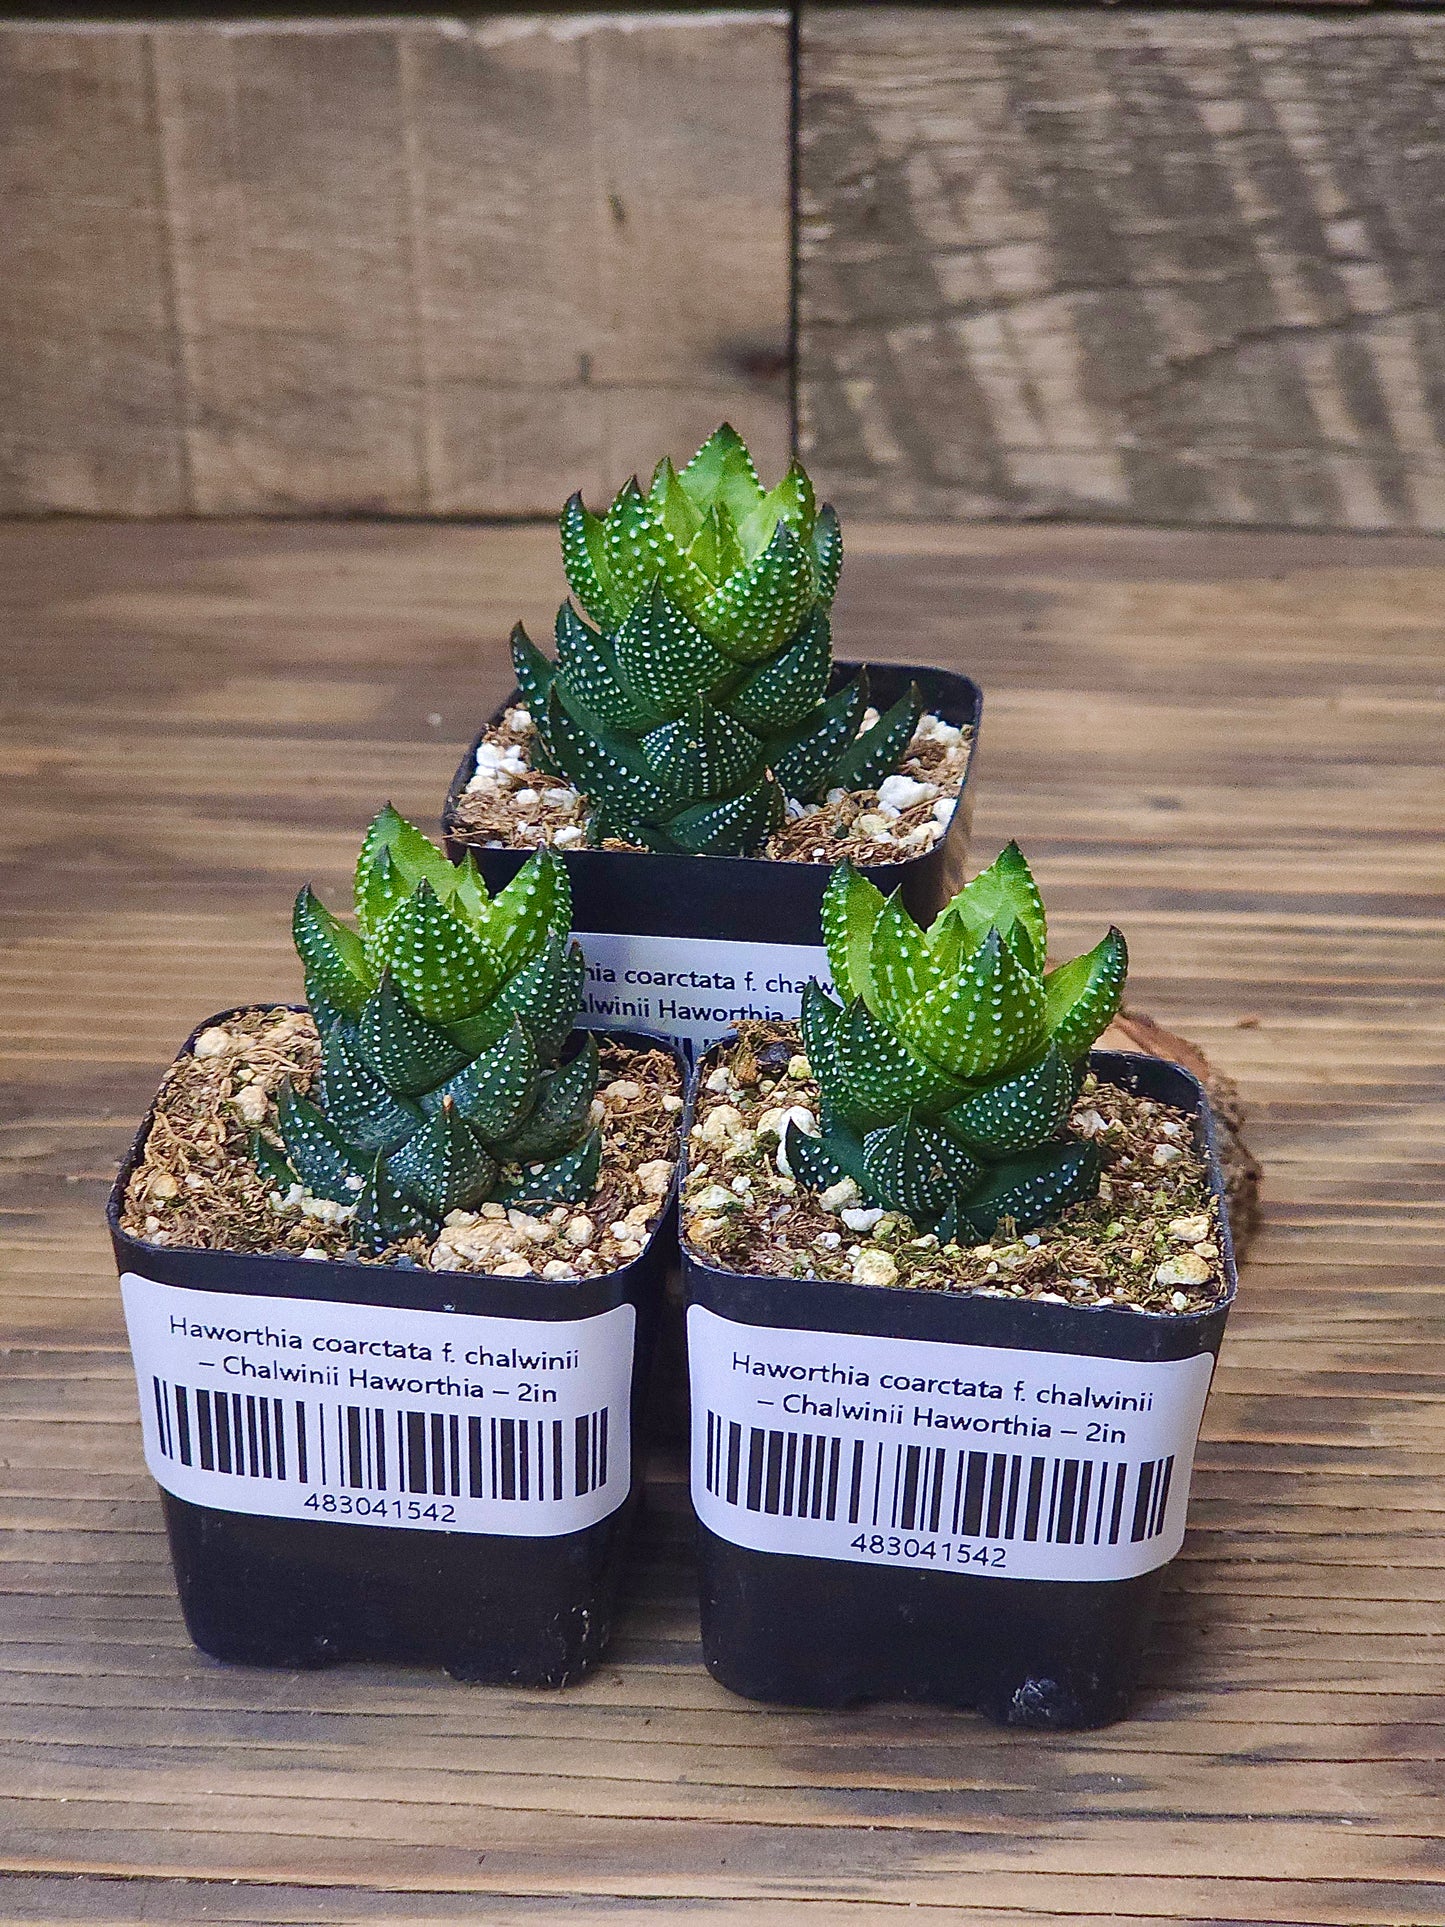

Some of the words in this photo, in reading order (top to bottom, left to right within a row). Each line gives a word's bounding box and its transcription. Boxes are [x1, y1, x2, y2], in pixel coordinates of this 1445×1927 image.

[624, 969, 736, 992] coarctata
[744, 971, 756, 992] f.
[578, 993, 650, 1018] alwinii
[658, 999, 784, 1021] Haworthia
[169, 1314, 302, 1350] Haworthia
[312, 1335, 432, 1362] coarctata
[442, 1343, 456, 1363] f.
[465, 1346, 579, 1371] chalwinii
[223, 1356, 339, 1387] Chalwinii
[349, 1368, 484, 1399] Haworthia
[518, 1382, 557, 1404] 2in
[732, 1351, 870, 1388] Haworthia
[879, 1373, 1003, 1401] coarctata
[1013, 1382, 1028, 1402] f.
[1036, 1385, 1153, 1412] chalwinii
[783, 1394, 903, 1425] Chalwinii
[913, 1408, 1052, 1439] Haworthia
[1086, 1423, 1126, 1444] 2in
[304, 1493, 456, 1523] 483041542
[850, 1534, 1008, 1568] 483041542
